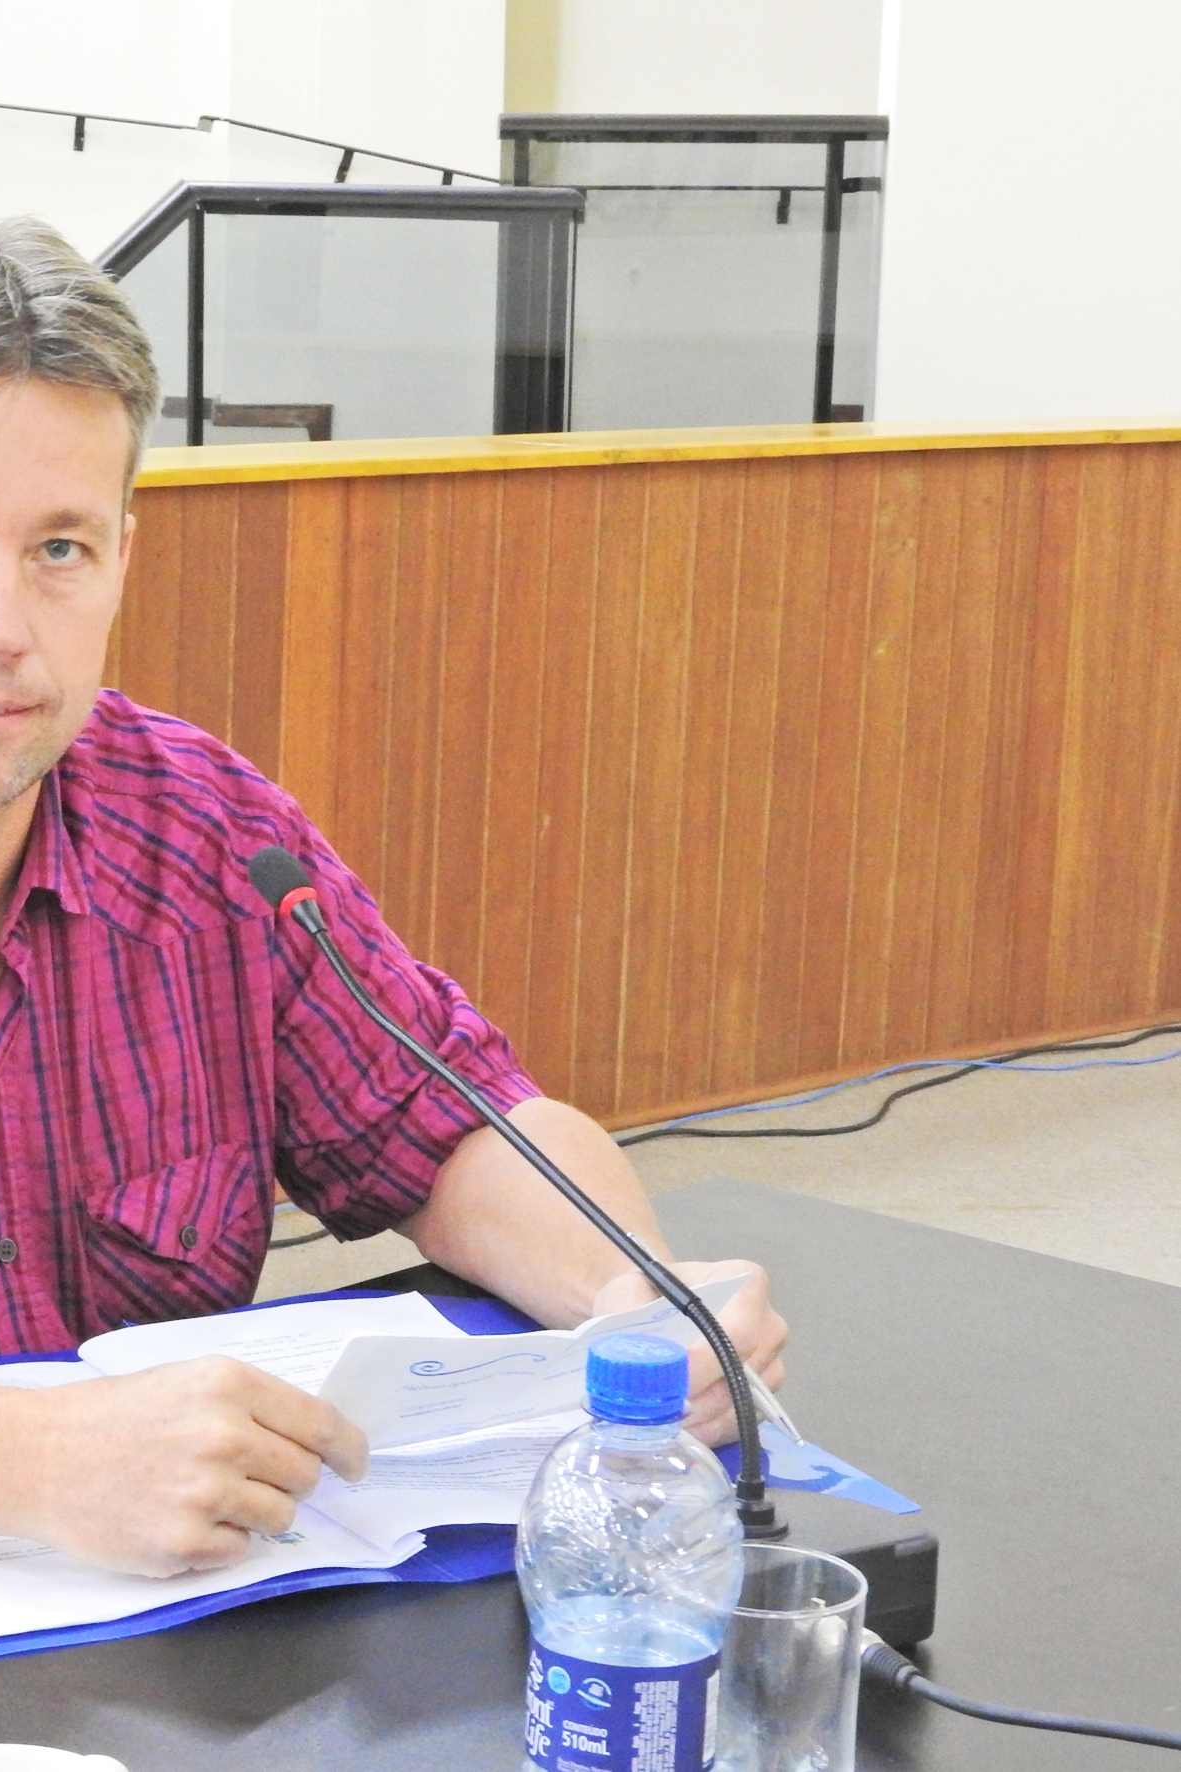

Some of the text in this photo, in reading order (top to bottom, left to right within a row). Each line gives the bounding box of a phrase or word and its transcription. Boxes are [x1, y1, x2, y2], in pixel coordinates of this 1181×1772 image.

[525, 1712, 550, 1757] Life
[562, 1719, 609, 1738] CONTEÚDO
[562, 1731, 610, 1756] 510mL
